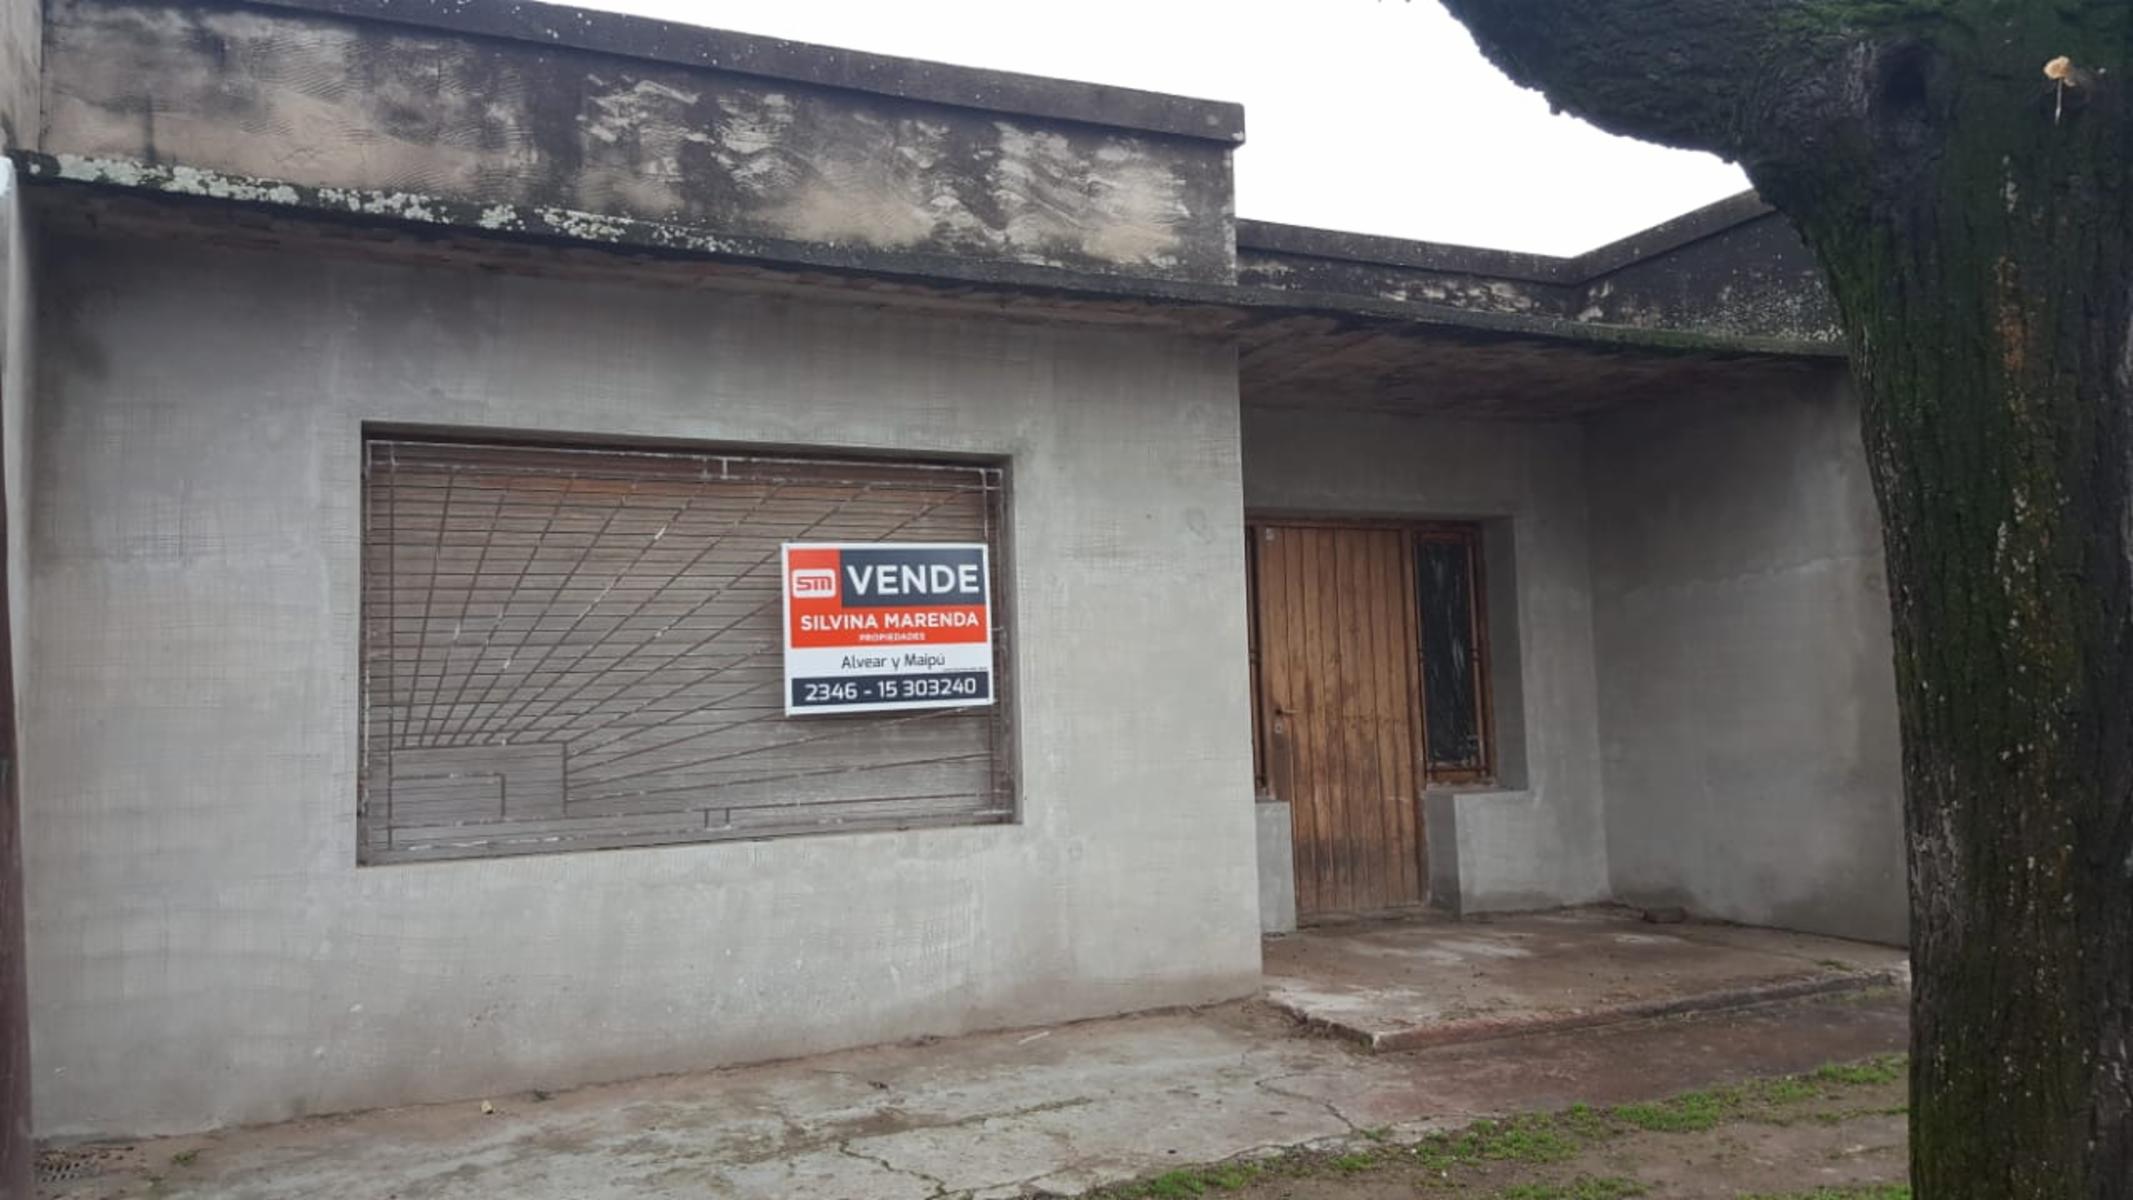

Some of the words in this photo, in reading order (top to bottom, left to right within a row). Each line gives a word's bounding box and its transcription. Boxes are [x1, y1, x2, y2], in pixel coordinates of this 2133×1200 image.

[846, 564, 980, 595] VENDE
[801, 613, 879, 631] SILVINA
[884, 612, 979, 629] MARENDA
[859, 632, 925, 642] PROPIEDADES
[841, 654, 887, 670] Alvear
[890, 657, 900, 671] y
[904, 653, 945, 669] Maipú
[804, 682, 858, 702] 2346
[878, 680, 898, 698] 15
[902, 677, 976, 697] 303240
